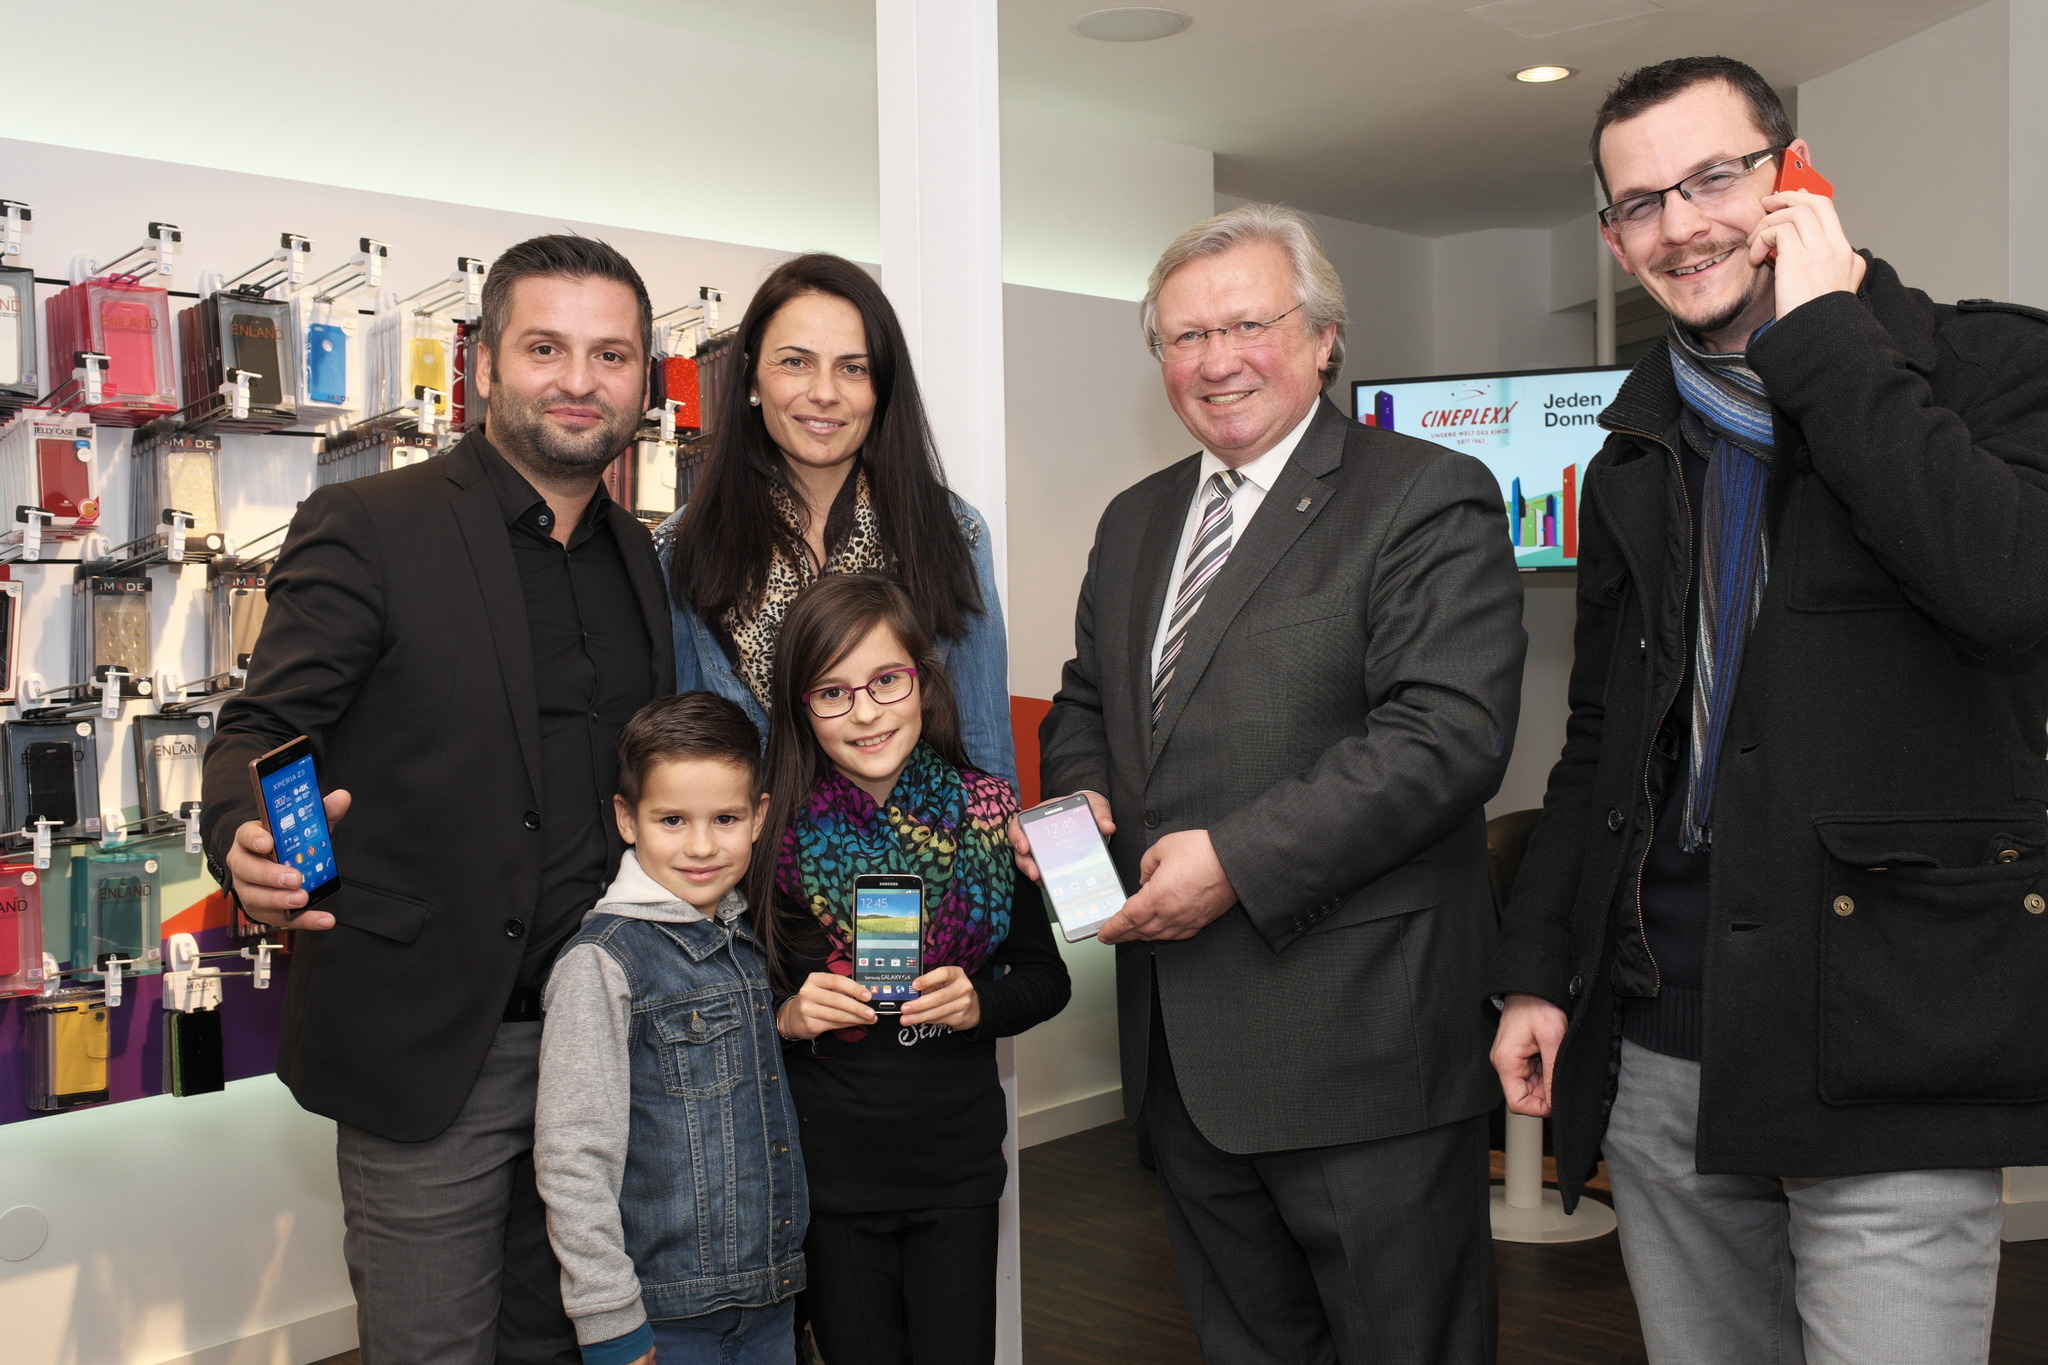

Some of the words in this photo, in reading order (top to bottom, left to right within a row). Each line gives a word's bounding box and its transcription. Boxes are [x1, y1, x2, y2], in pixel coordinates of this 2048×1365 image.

[101, 316, 159, 330] ENLAND
[231, 322, 285, 340] ENLAND
[1543, 392, 1602, 409] Jeden
[1421, 400, 1519, 428] CINEPLEXX
[1545, 413, 1597, 427] Donn
[34, 426, 54, 436] JELLY
[55, 428, 75, 436] CASE
[1430, 431, 1457, 439] UNSERE
[169, 437, 215, 449] iMADE
[393, 435, 433, 447] iMADE
[99, 581, 146, 592] iMADE
[232, 577, 266, 587] iMAD
[154, 742, 207, 757] ENLAND
[272, 774, 297, 790] XPERIA
[296, 769, 305, 779] Z3
[100, 884, 152, 900] ENLAND
